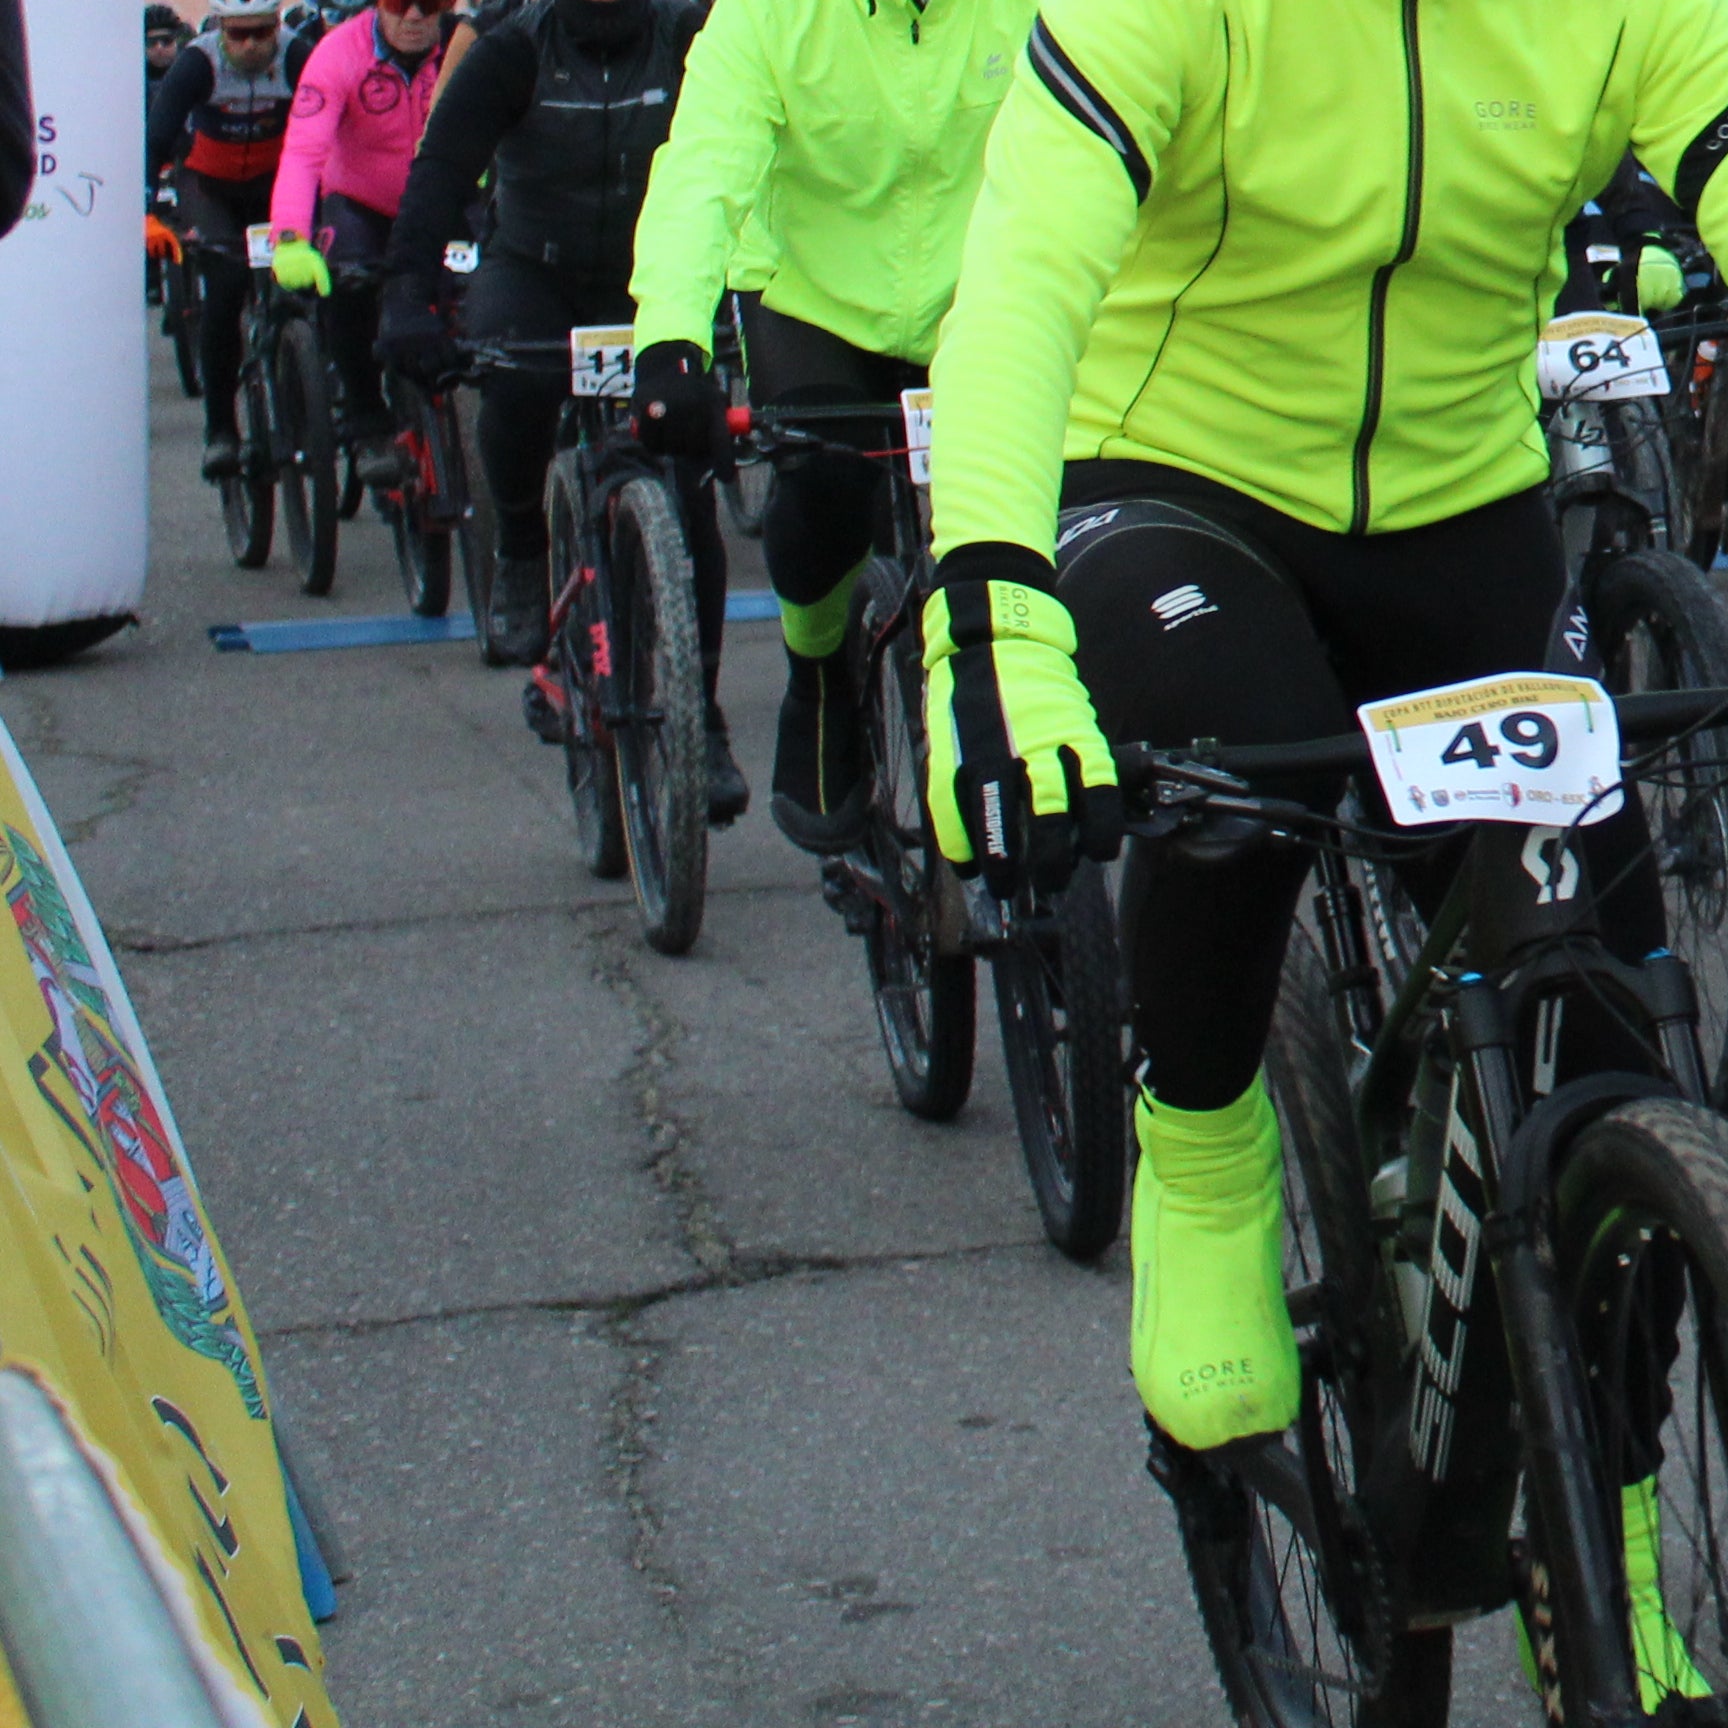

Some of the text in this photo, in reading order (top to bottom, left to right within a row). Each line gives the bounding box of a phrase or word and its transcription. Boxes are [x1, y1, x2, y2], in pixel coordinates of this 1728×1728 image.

[1474, 99, 1537, 119] GORE
[1568, 339, 1631, 374] 64
[1439, 711, 1559, 770] 49
[1180, 1357, 1254, 1387] GORE
